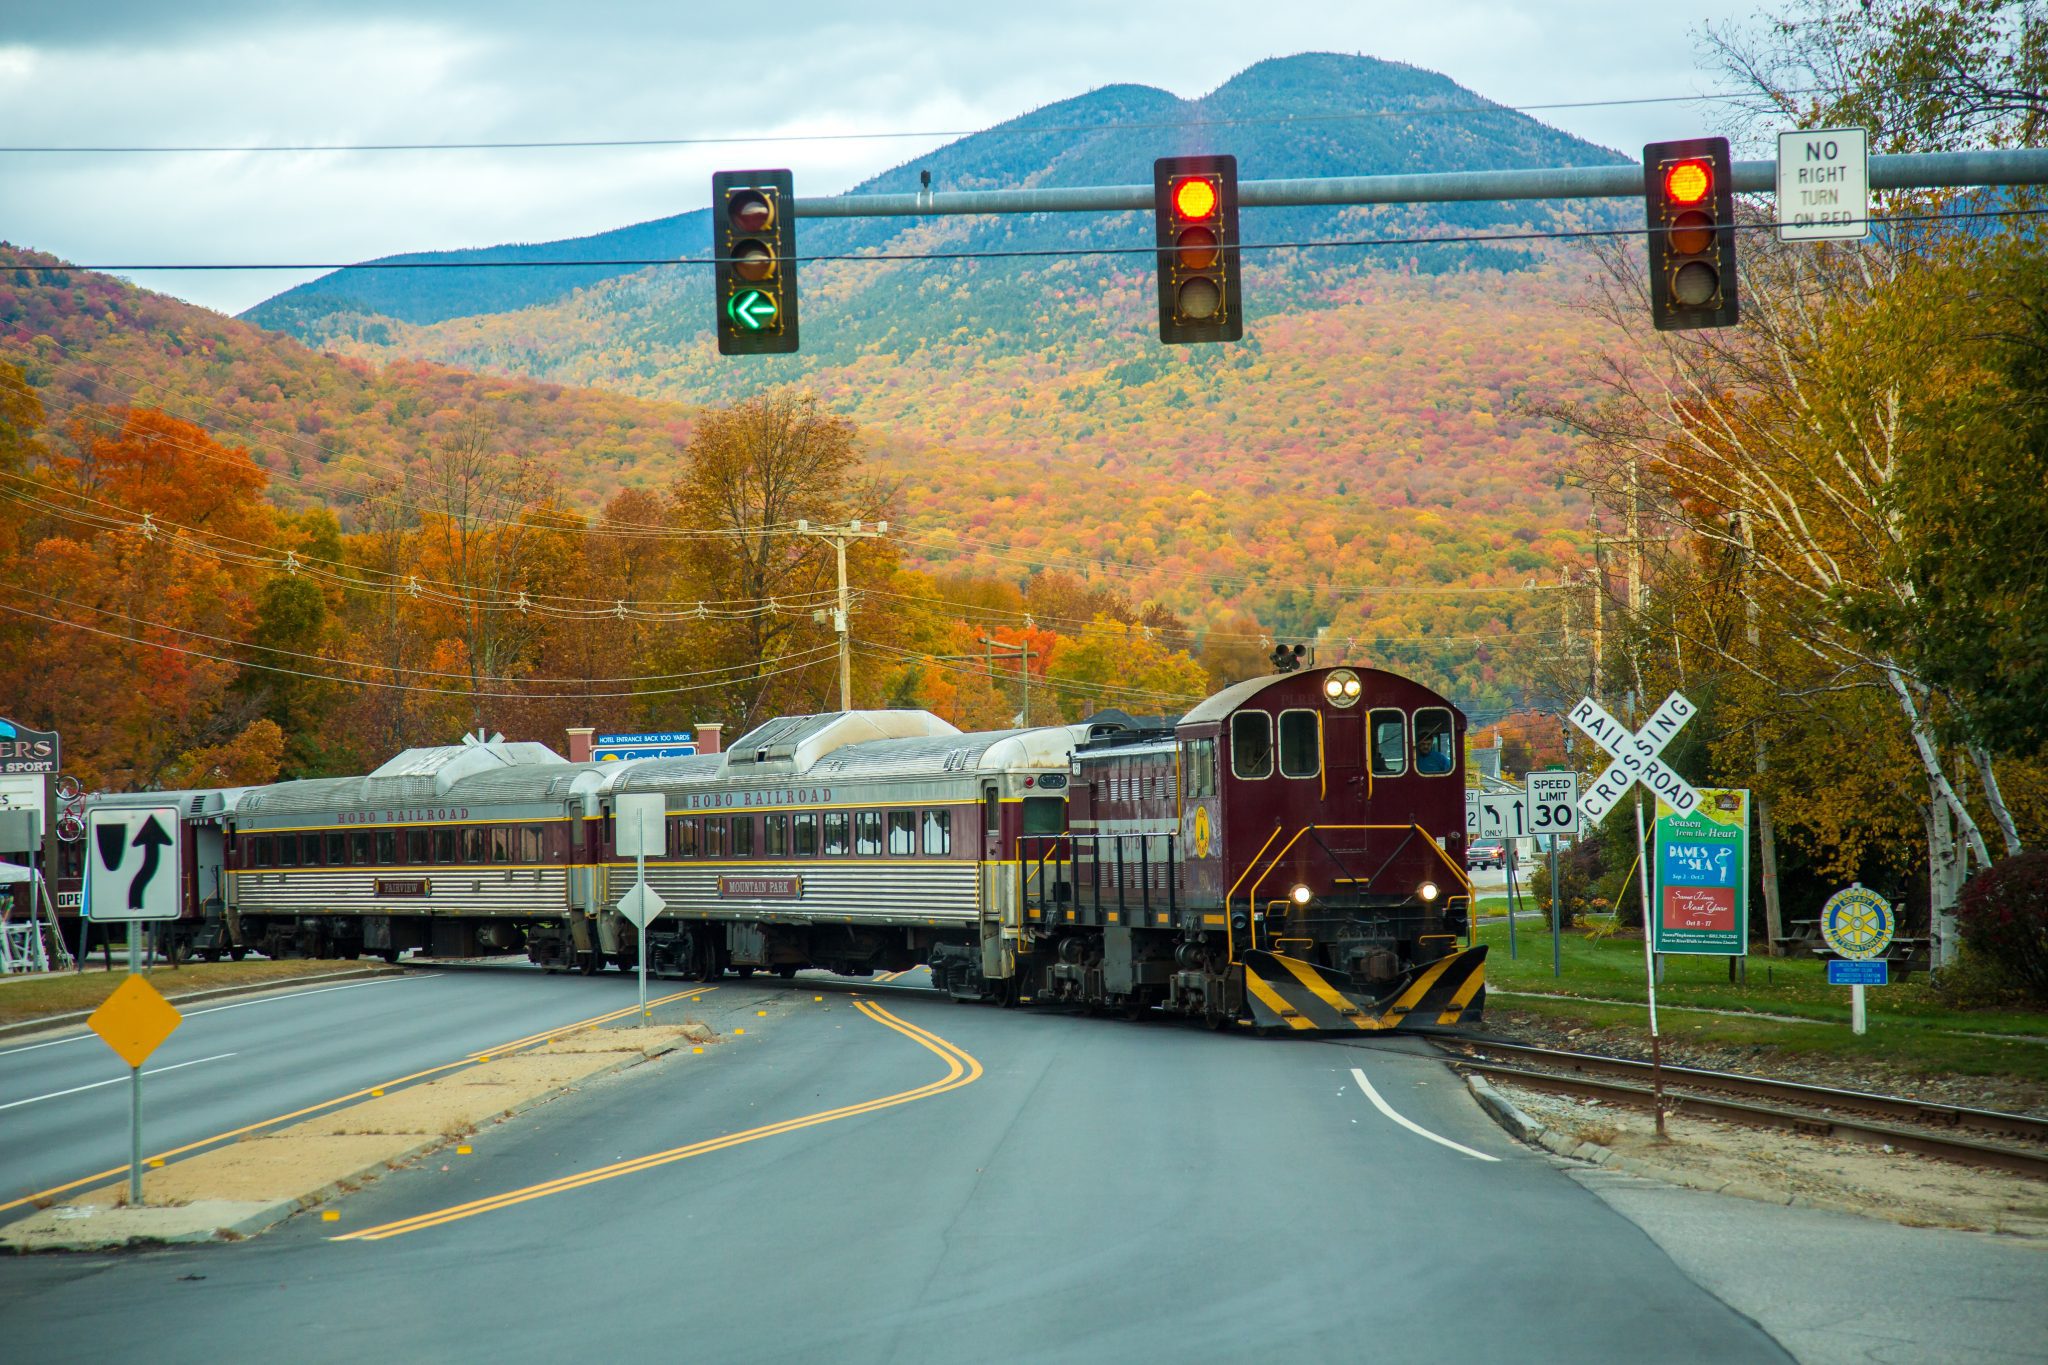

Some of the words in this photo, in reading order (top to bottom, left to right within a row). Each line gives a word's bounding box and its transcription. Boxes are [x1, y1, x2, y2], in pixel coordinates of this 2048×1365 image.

[1806, 141, 1838, 161] NO
[1798, 166, 1847, 184] RIGHT
[1800, 189, 1838, 206] TURN
[1794, 212, 1814, 229] ON
[1821, 211, 1852, 228] RED
[1574, 703, 1624, 754] RAIL
[1641, 761, 1694, 809] ROAD
[1584, 699, 1688, 816] CROSSING
[6, 761, 53, 772] SPORT
[1533, 780, 1571, 789] SPEED
[692, 793, 733, 808] HOBO
[744, 788, 832, 806] RAILROAD
[1539, 792, 1568, 801] LIMIT
[338, 812, 376, 824] HOBO
[387, 808, 469, 822] RAILROAD
[1535, 804, 1572, 827] 30
[1668, 818, 1701, 828] Season
[1675, 829, 1693, 837] from
[1695, 829, 1707, 837] the
[1708, 828, 1737, 838] Heart
[1669, 845, 1708, 858] DAMES
[1688, 858, 1713, 871] SEA
[384, 883, 418, 893] FAIRVIEW
[729, 881, 767, 893] MOUNTAIN
[769, 881, 789, 893] PARK
[59, 893, 82, 906] OPE
[1682, 900, 1704, 911] Next
[1705, 901, 1728, 913] Year
